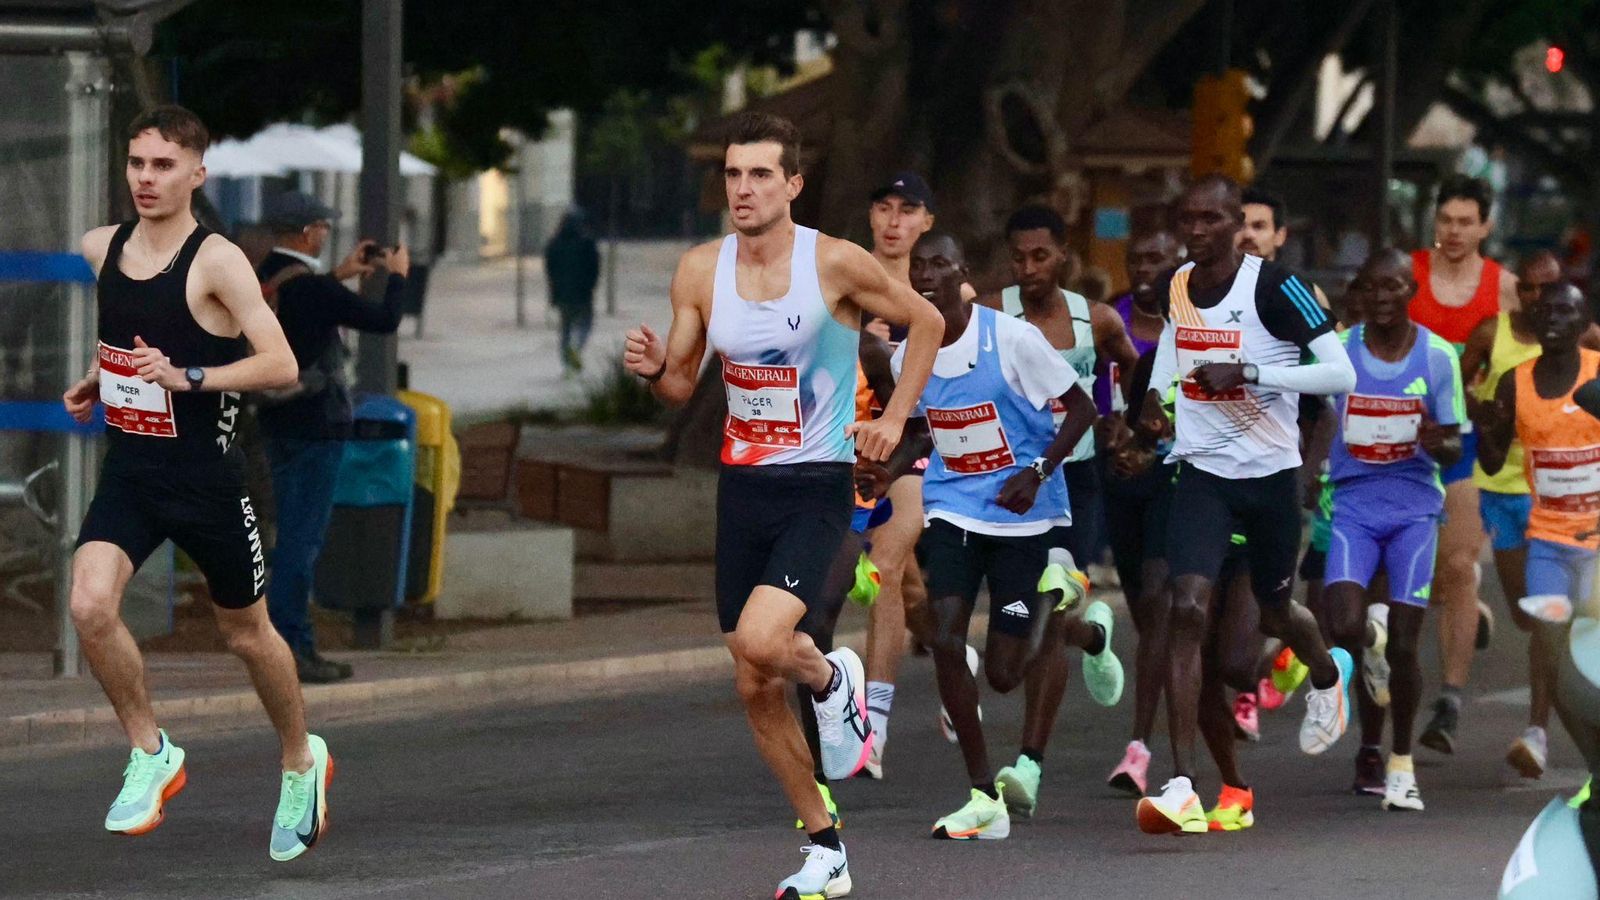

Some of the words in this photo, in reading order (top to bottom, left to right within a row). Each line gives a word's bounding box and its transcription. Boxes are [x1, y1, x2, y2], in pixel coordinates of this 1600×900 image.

[1187, 331, 1235, 343] GENERALI
[734, 367, 791, 382] GENERALI
[116, 383, 140, 396] PACER
[124, 397, 133, 405] 40
[940, 406, 990, 422] GENERALI
[240, 496, 257, 528] 247
[247, 526, 265, 596] TEAM
